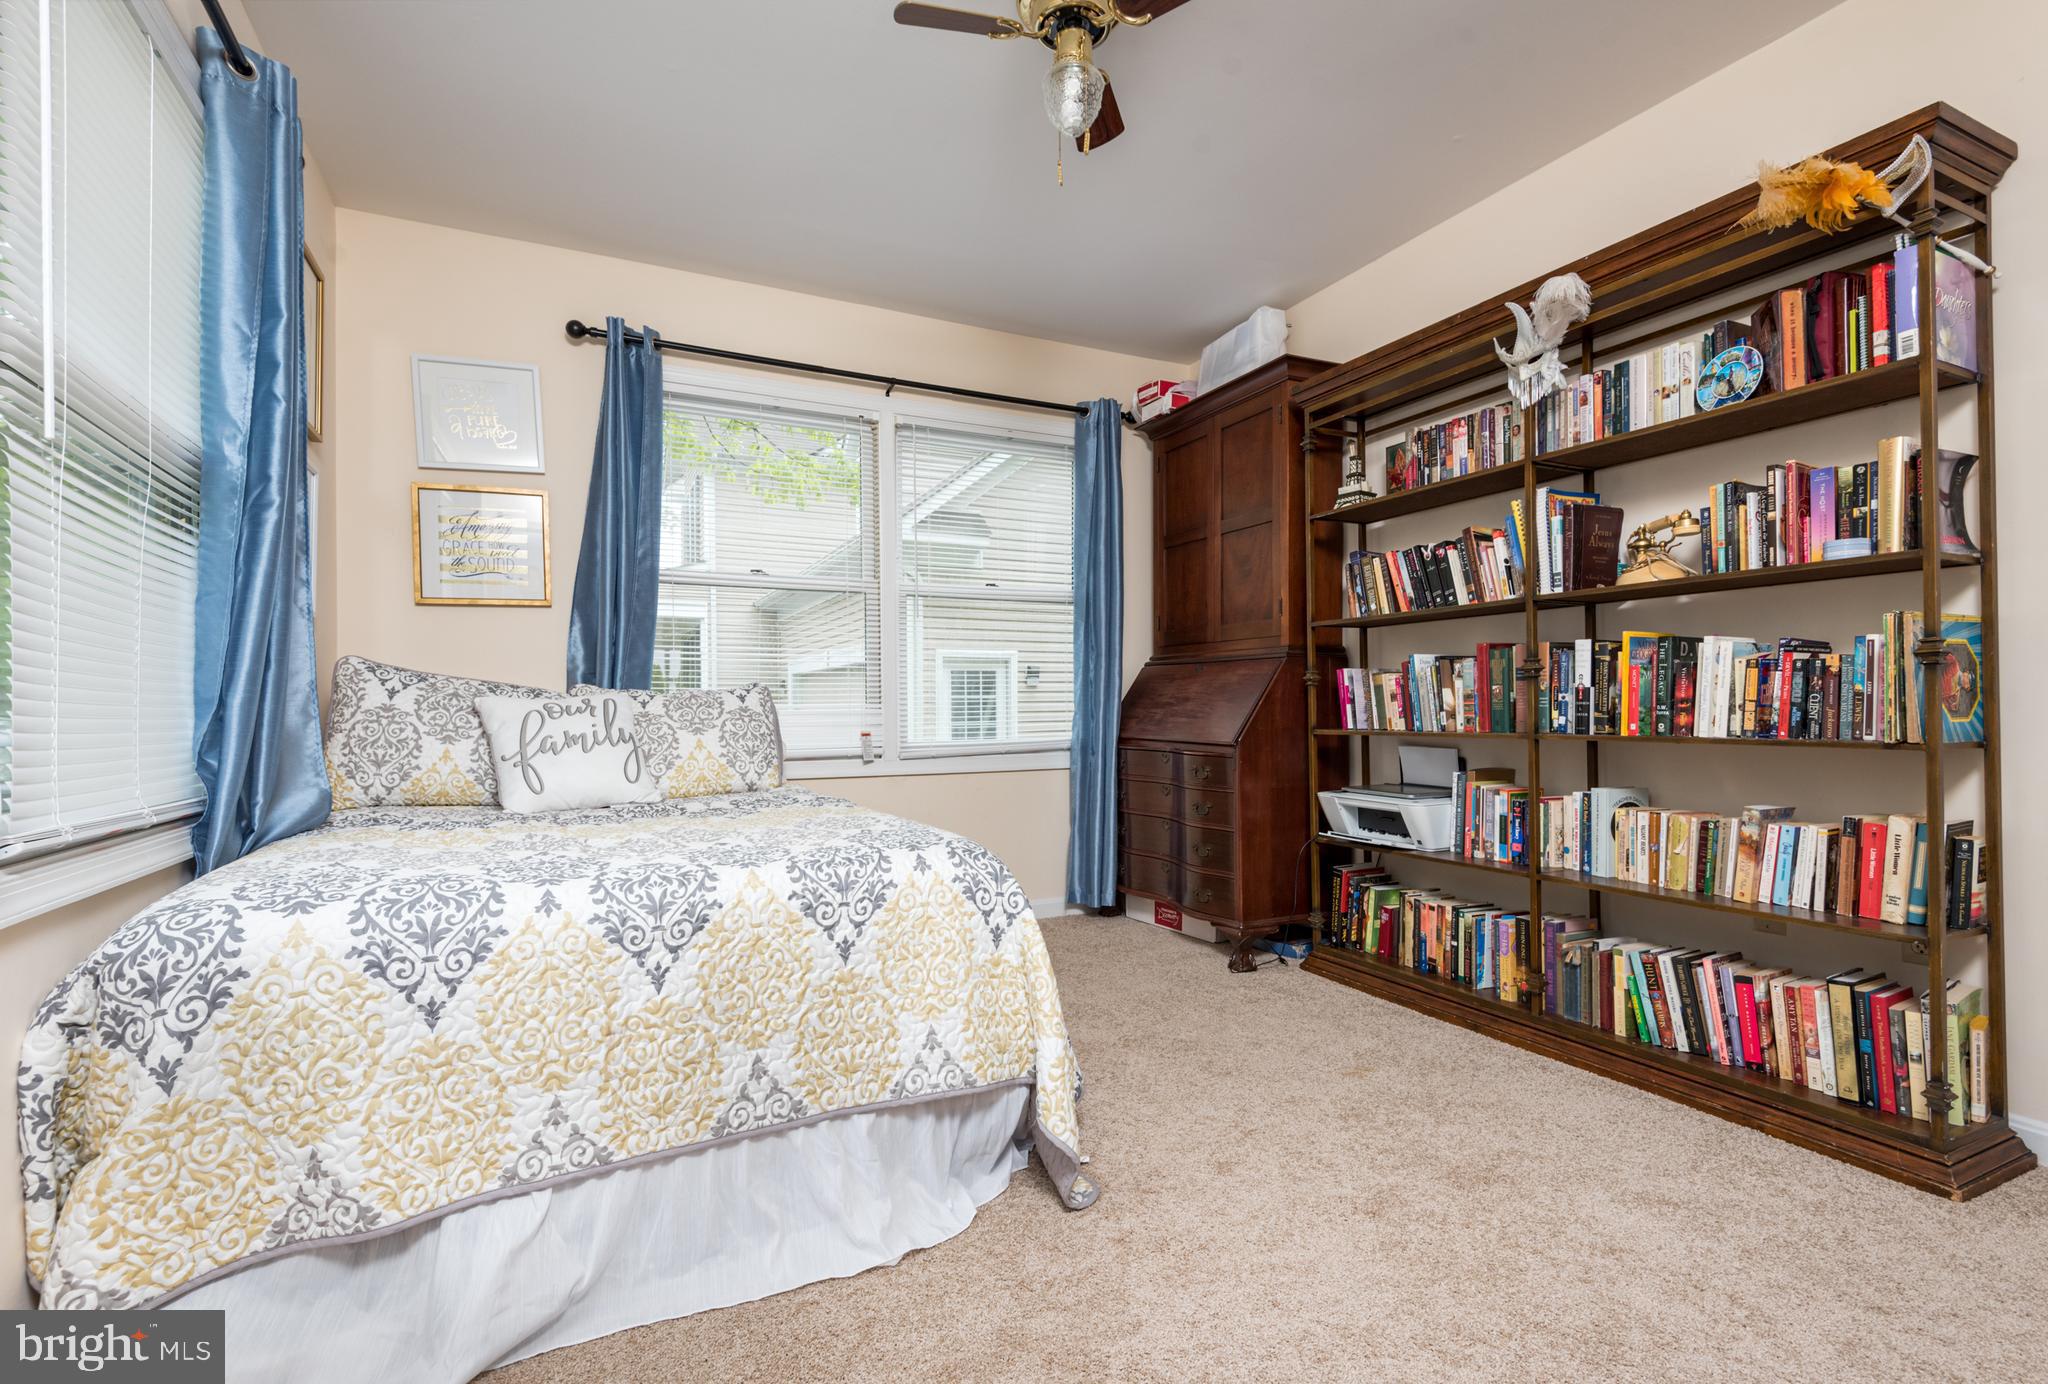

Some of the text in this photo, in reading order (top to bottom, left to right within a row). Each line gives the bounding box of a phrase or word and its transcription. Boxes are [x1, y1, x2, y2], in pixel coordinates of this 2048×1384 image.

[1588, 535, 1615, 550] Always
[1592, 523, 1612, 537] Jesus
[442, 538, 484, 557] GRACE
[467, 556, 516, 573] SOUND
[1658, 640, 1669, 697] THE LEGACY
[543, 698, 597, 720] our
[1808, 693, 1821, 720] CLIENT
[1854, 695, 1862, 722] LEWIS
[1826, 706, 1835, 738] Jackaroo
[500, 698, 645, 795] family
[1868, 860, 1876, 879] Women
[1892, 852, 1901, 876] Women
[1643, 963, 1659, 991] HUNT
[1787, 998, 1798, 1033] AMY TAN
